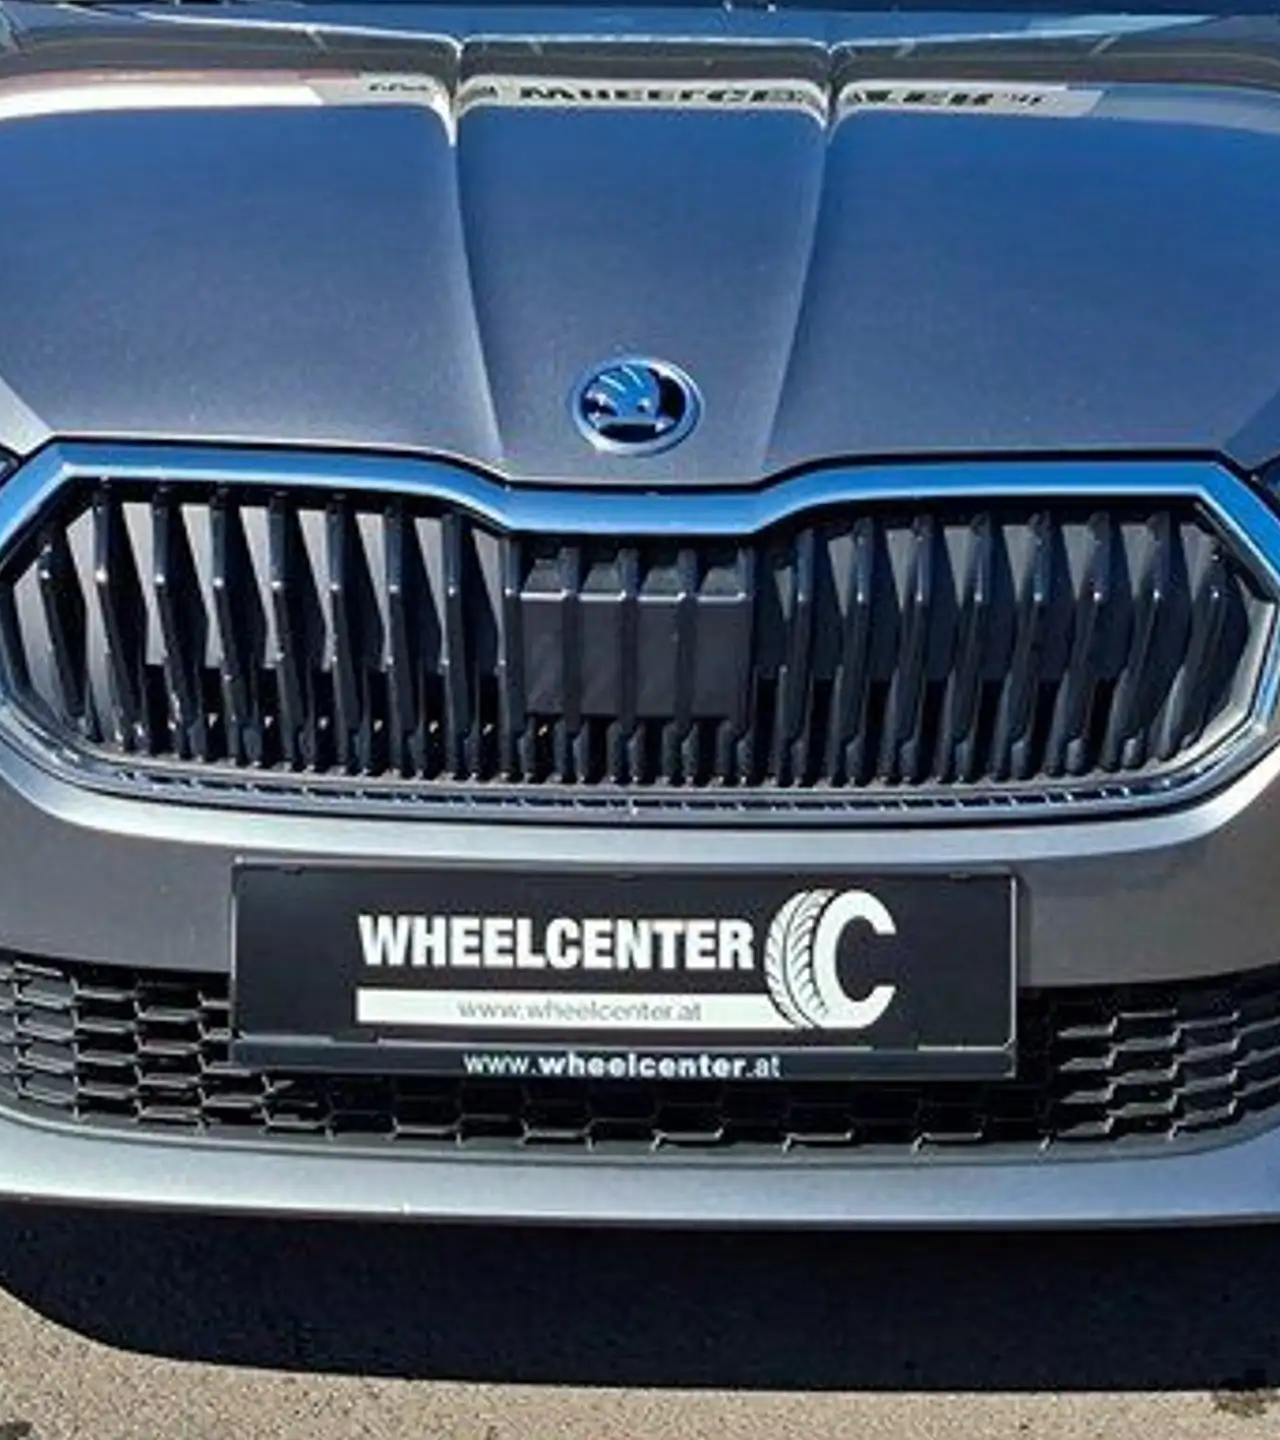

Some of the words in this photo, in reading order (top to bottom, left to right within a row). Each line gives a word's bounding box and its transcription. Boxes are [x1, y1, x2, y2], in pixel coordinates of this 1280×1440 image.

[358, 914, 755, 971] WHEELCENTER
[456, 999, 702, 1023] www.wheelcenter.at
[463, 1050, 782, 1080] www.wheelcenter.at
